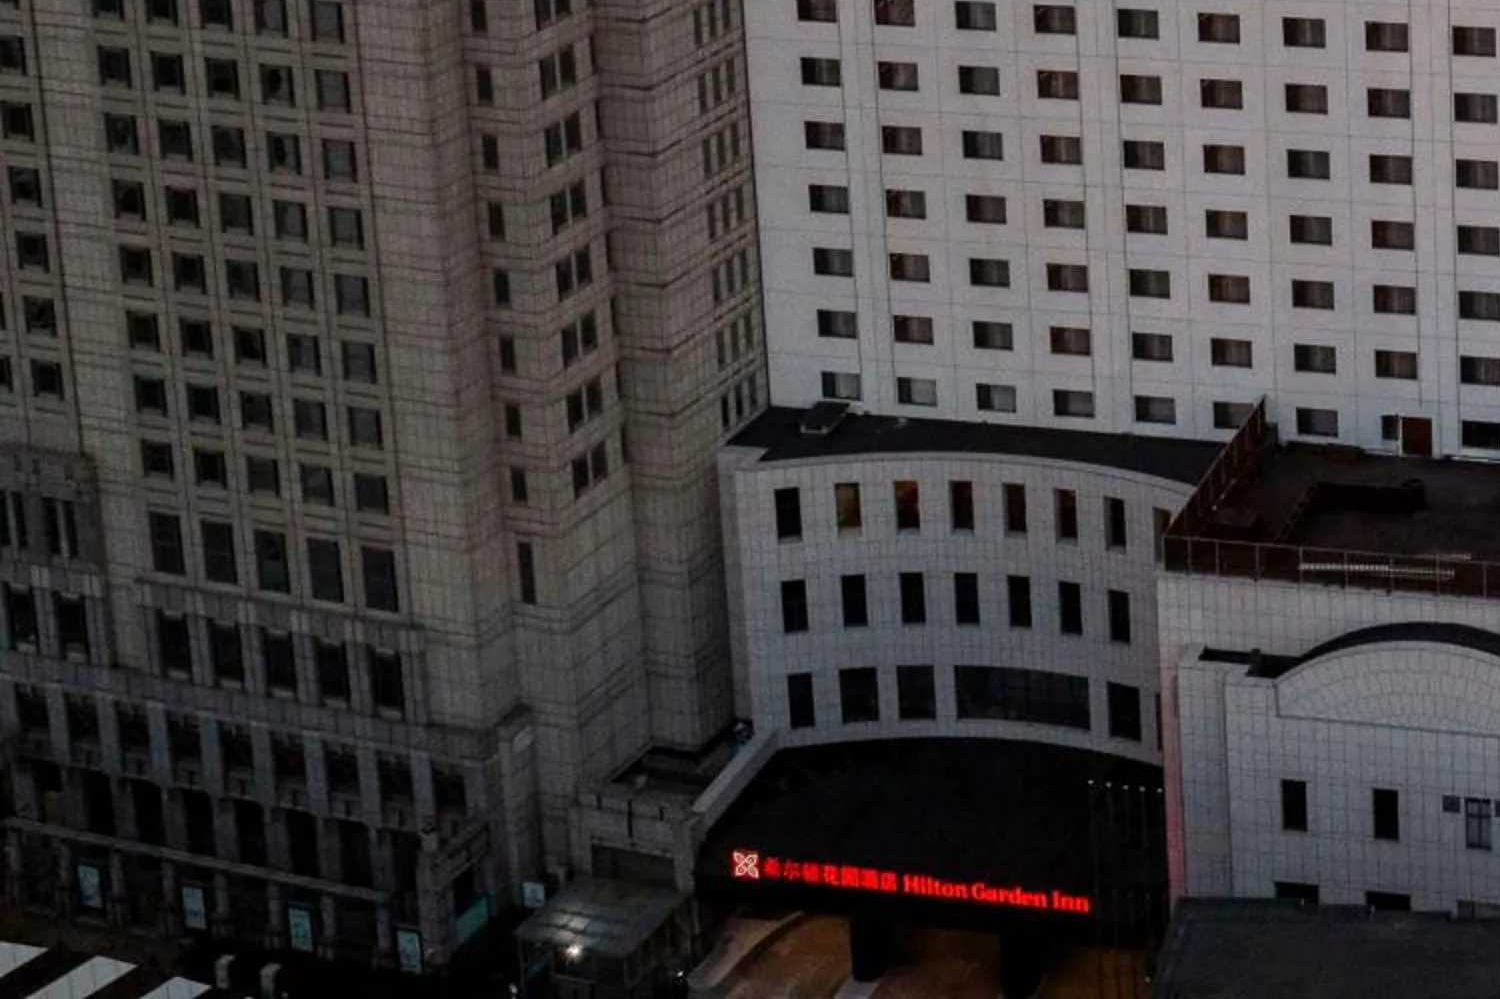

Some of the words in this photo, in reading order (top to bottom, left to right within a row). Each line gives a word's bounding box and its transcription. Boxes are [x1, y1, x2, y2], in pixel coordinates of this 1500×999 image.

[903, 874, 969, 900] Hilton
[971, 882, 1048, 909] Garden
[1052, 890, 1090, 913] Inn
